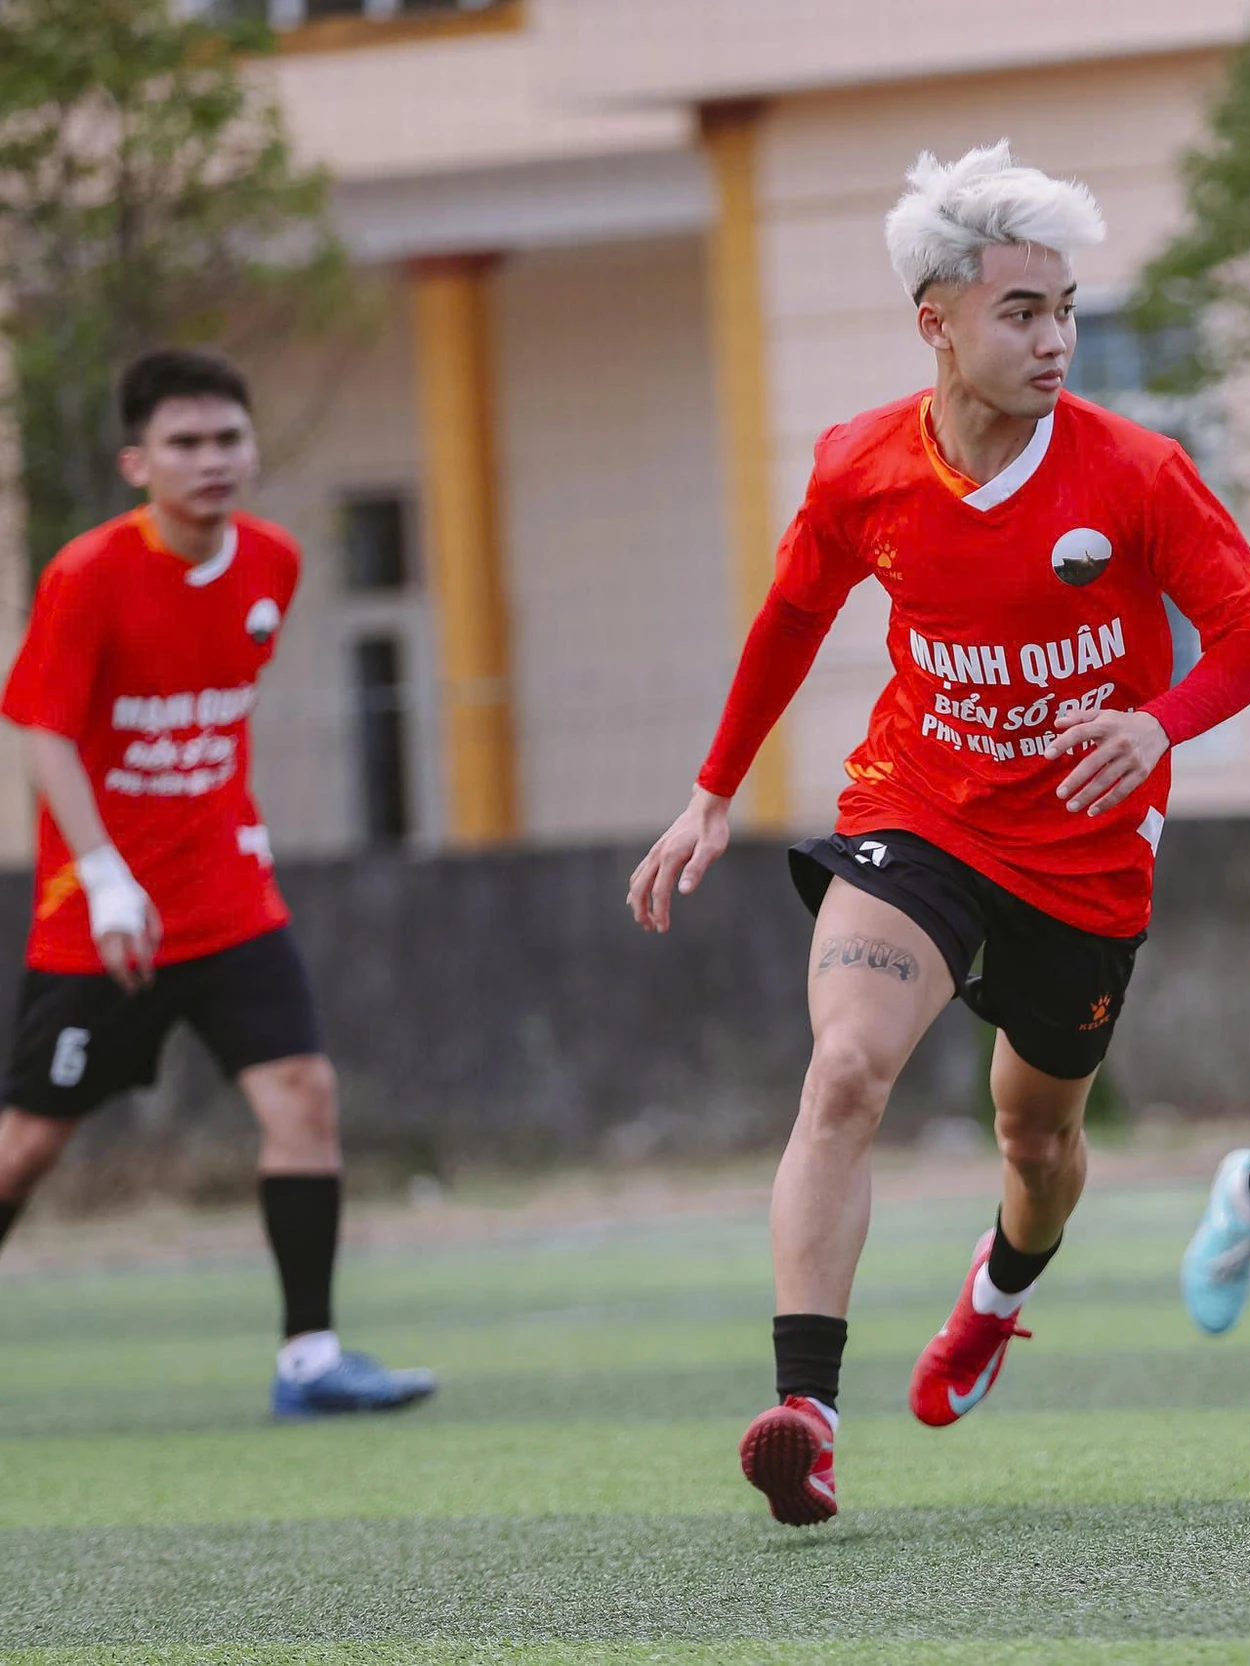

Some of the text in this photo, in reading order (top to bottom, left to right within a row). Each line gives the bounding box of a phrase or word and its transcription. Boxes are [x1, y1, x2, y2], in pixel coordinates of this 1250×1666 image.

[909, 617, 1126, 690] MẠNH QUÂN
[934, 693, 999, 729] BIỂN
[1002, 692, 1056, 732] SỐ
[921, 713, 963, 751] PHỤ
[966, 734, 1016, 762] KIN
[816, 936, 917, 981] 2004
[49, 1026, 91, 1088] 6
